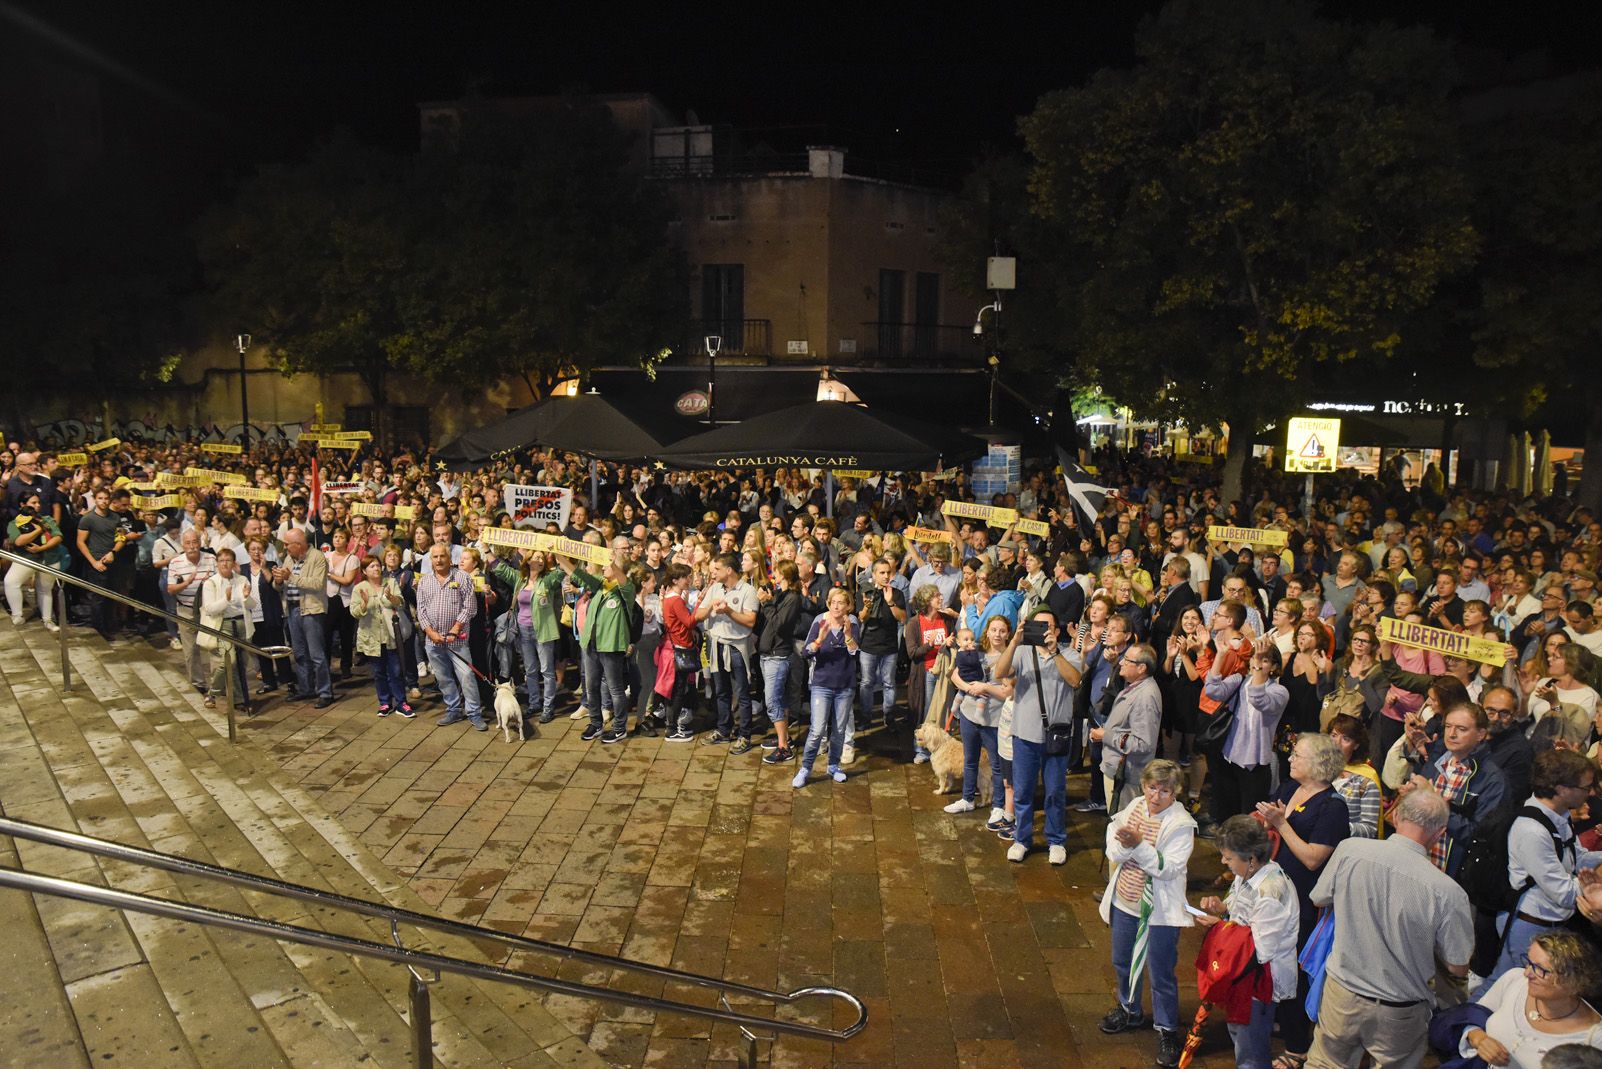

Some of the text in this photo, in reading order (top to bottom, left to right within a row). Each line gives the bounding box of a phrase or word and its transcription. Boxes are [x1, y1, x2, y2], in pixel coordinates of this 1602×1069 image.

[716, 456, 858, 467] CATALUNYA CAFÈ
[515, 488, 562, 499] LLIBERTAT
[514, 498, 561, 511] PRESOS
[949, 501, 995, 519] LLIBERTAT!
[514, 509, 560, 520] POLITICS!
[487, 528, 538, 547] LLIBERTAT!
[1215, 527, 1264, 541] LLIBERTAT!
[555, 539, 593, 558] LLIBERTAT!
[1389, 620, 1471, 655] LLIBERTAT!
